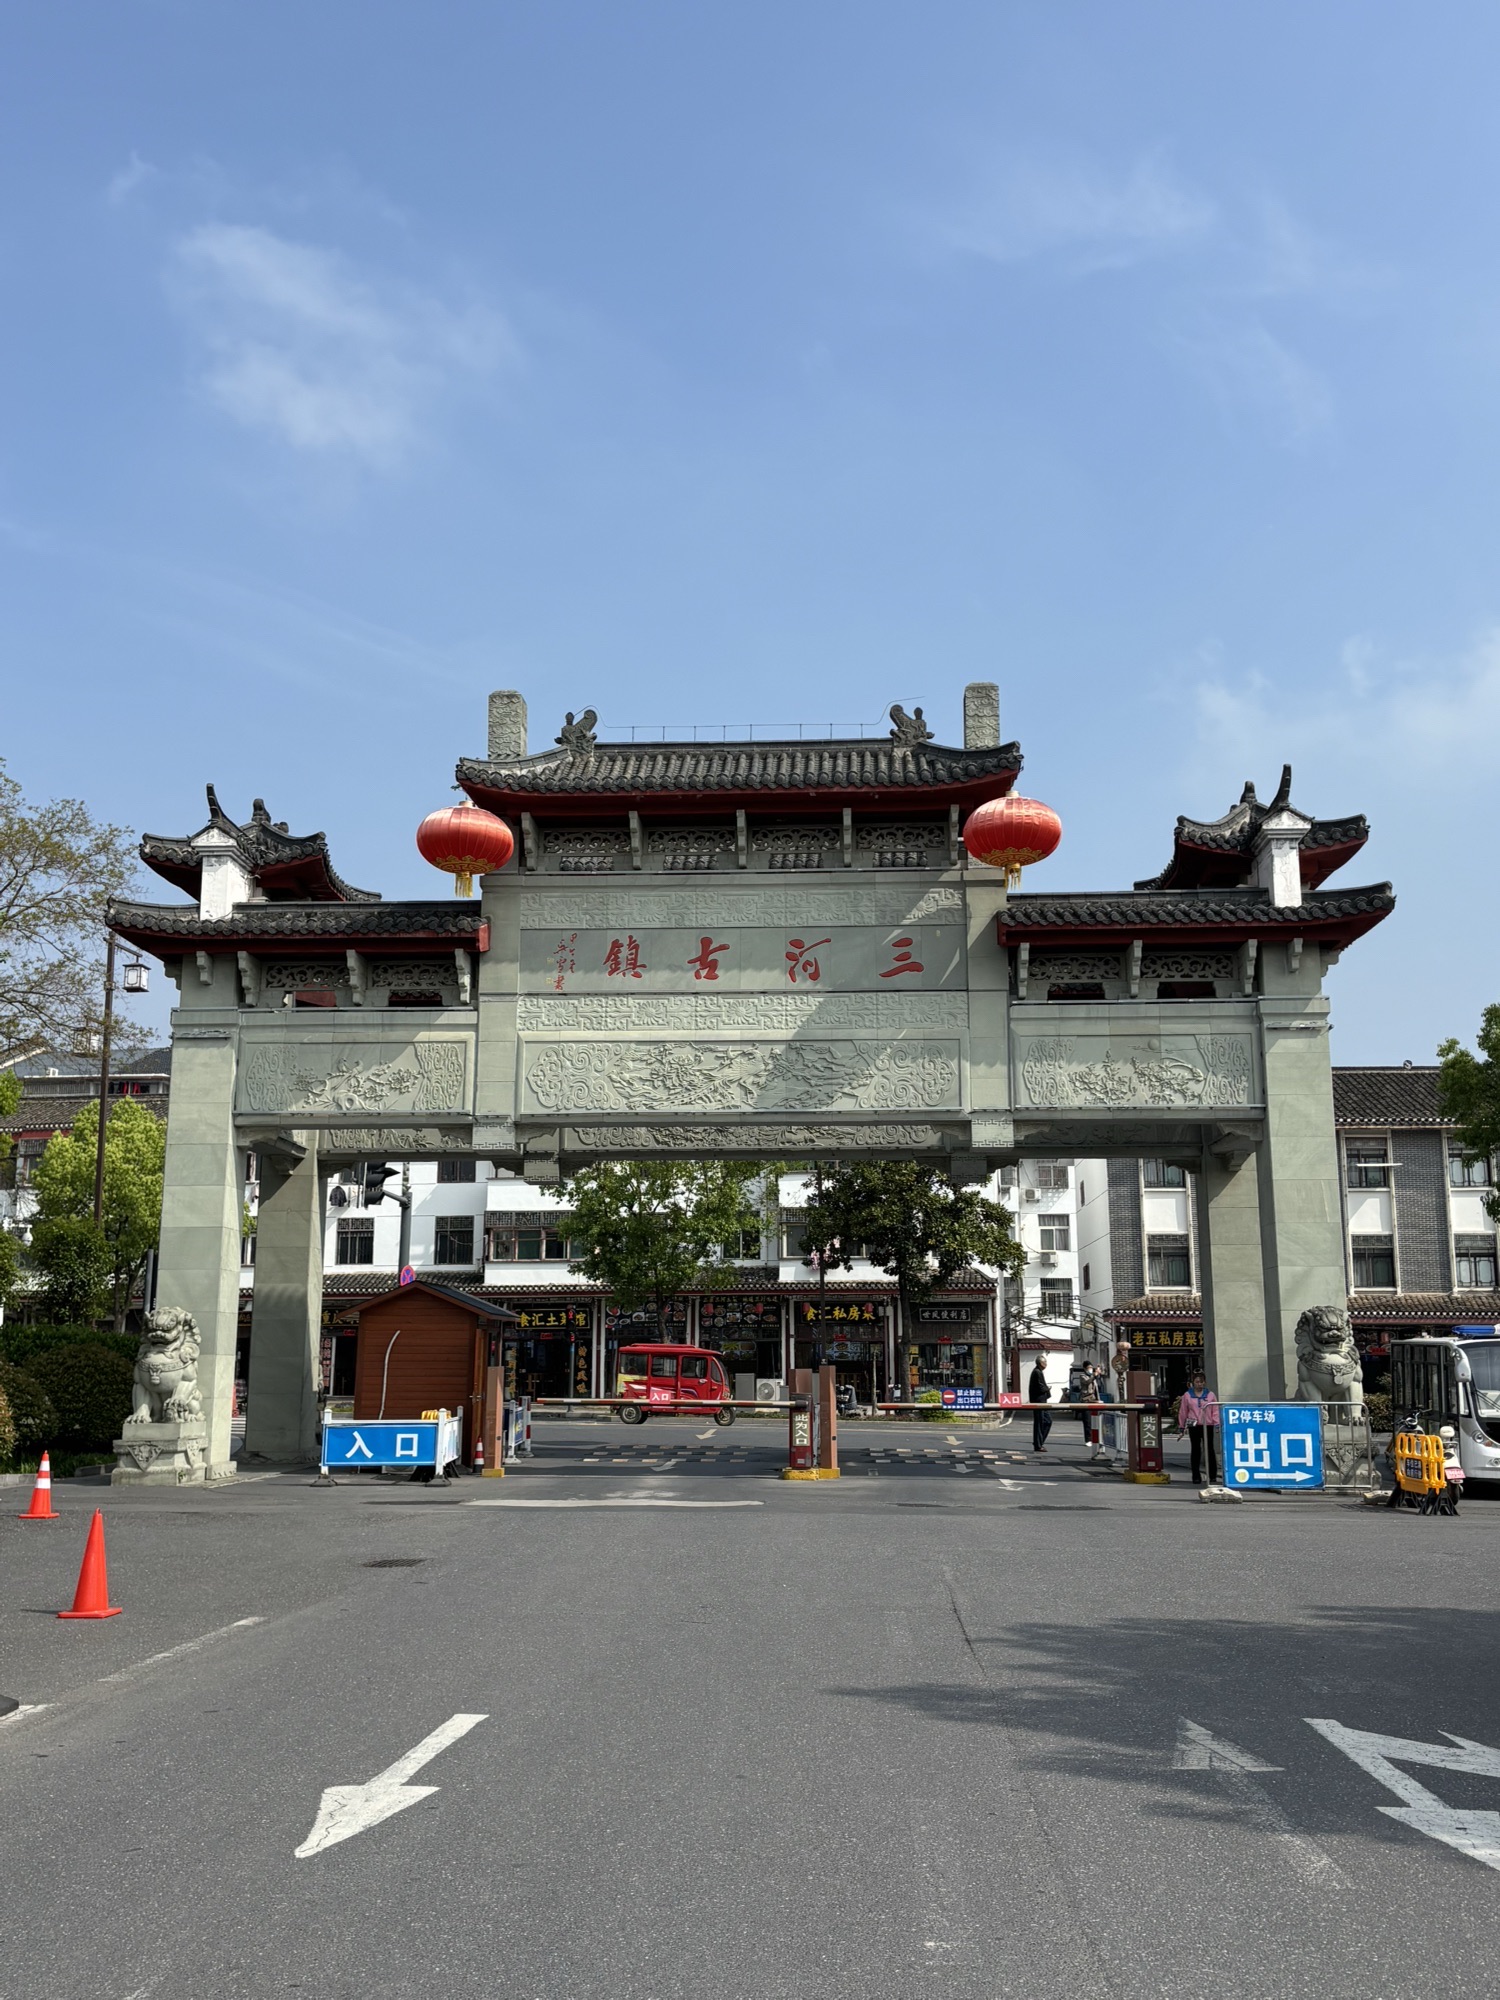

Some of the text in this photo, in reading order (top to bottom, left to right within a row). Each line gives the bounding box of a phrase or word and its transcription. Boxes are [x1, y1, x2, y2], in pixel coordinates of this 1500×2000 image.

[803, 1305, 876, 1321] 食汇私房菜
[652, 1393, 669, 1401] 入口
[1002, 1396, 1020, 1404] 入口
[795, 1414, 809, 1445] 此为入口
[1142, 1415, 1157, 1447] 此为入口
[345, 1431, 419, 1458] 入口
[1233, 1428, 1314, 1469] 出口
